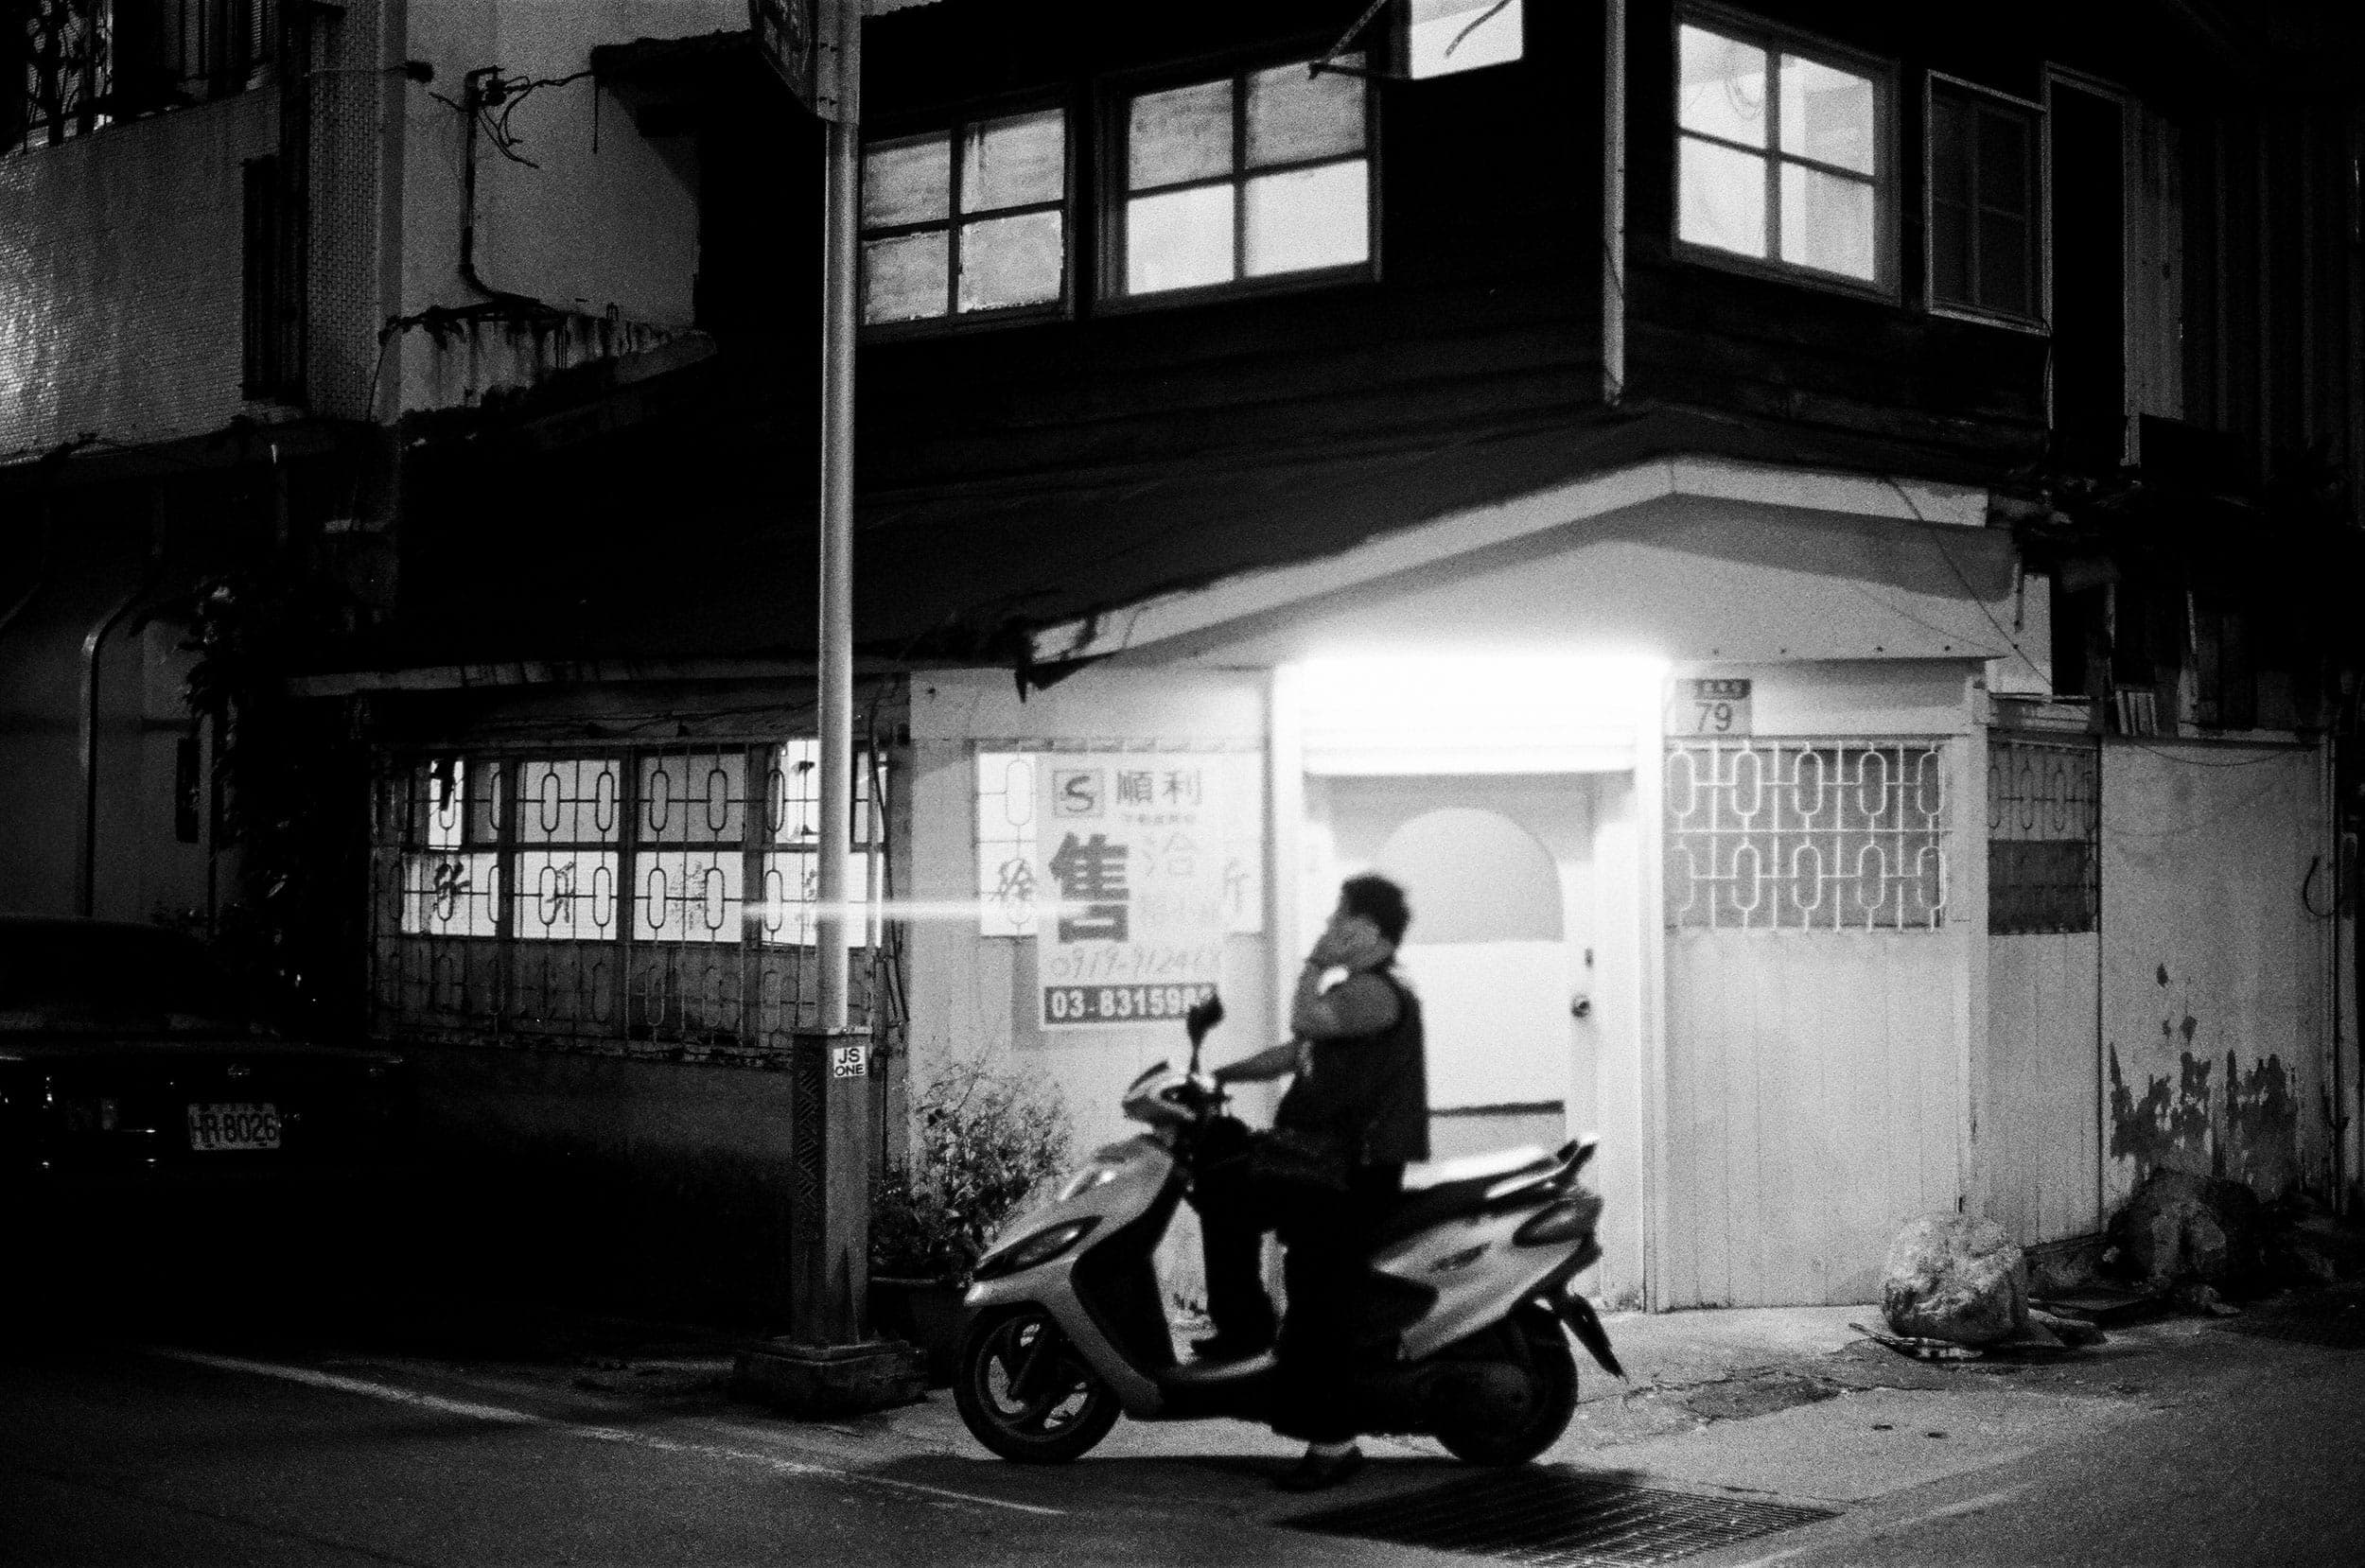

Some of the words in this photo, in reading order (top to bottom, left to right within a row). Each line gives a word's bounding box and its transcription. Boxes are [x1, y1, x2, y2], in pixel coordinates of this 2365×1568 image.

[1694, 703, 1733, 732] 79
[1116, 770, 1203, 806] 順利
[1047, 831, 1130, 944] 售
[834, 1063, 865, 1076] ONE
[837, 1047, 861, 1064] JS
